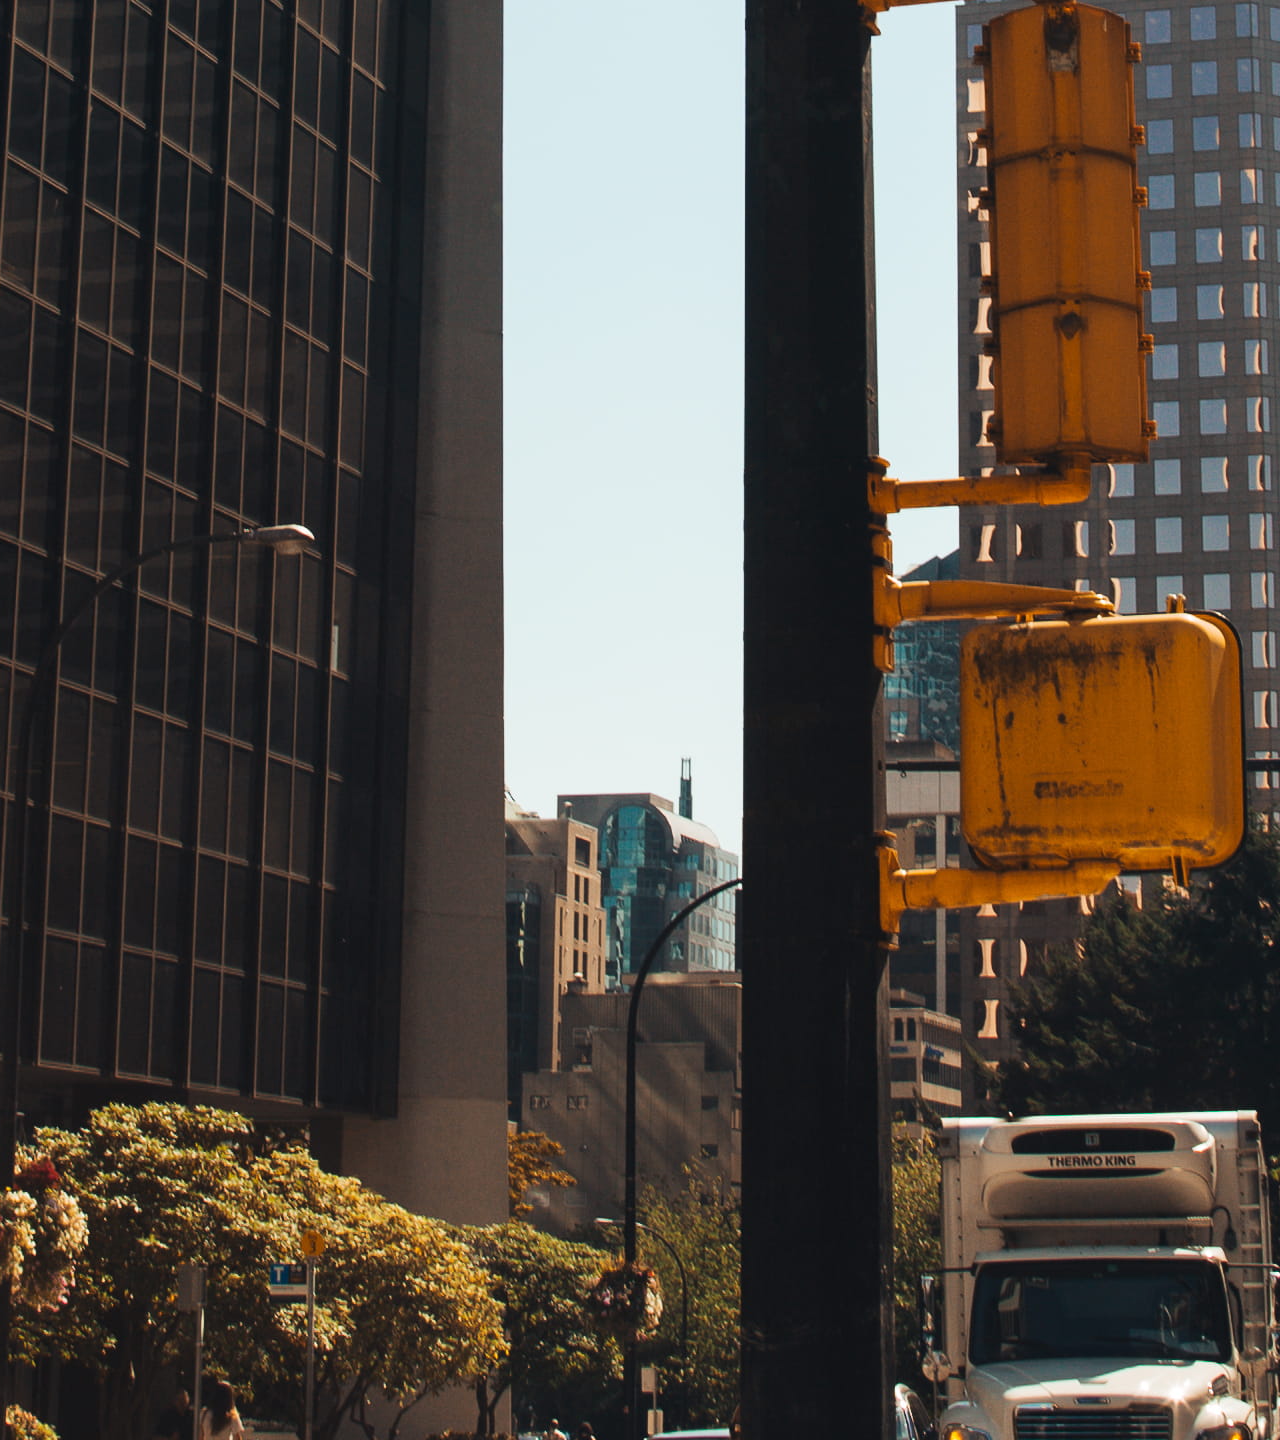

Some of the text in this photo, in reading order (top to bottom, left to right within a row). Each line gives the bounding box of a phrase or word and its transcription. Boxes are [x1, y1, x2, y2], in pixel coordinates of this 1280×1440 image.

[1048, 1155, 1136, 1167] THERMO KING
[273, 1266, 284, 1283] T
